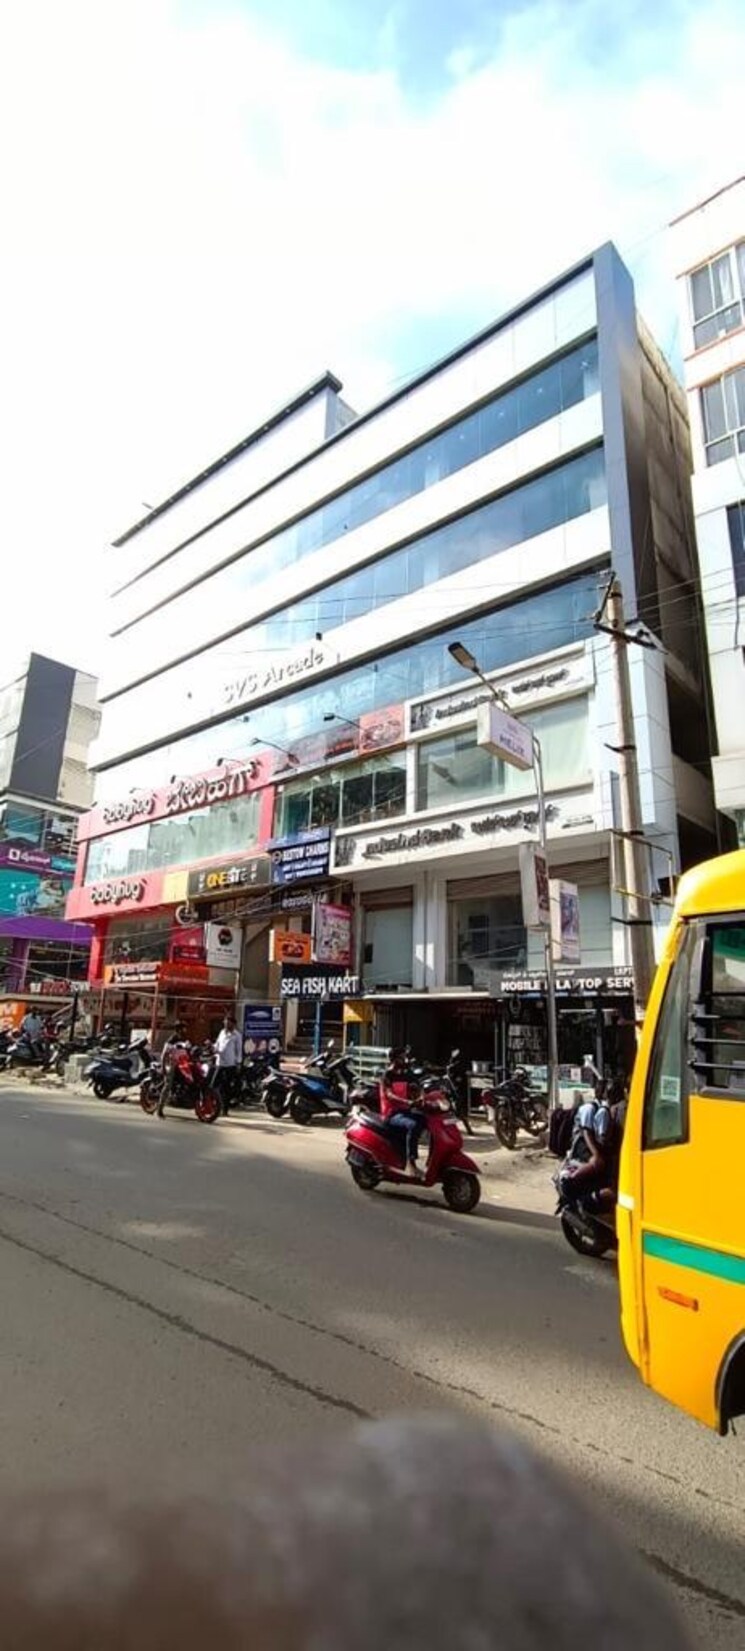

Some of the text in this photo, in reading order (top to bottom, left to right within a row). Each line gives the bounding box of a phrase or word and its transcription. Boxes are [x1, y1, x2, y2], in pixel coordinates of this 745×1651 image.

[223, 646, 325, 703] SVS Arcade
[103, 792, 158, 825] babyhug
[90, 878, 147, 905] babyhug
[281, 976, 358, 995] SEA FISH KART
[500, 979, 542, 992] MOBILE
